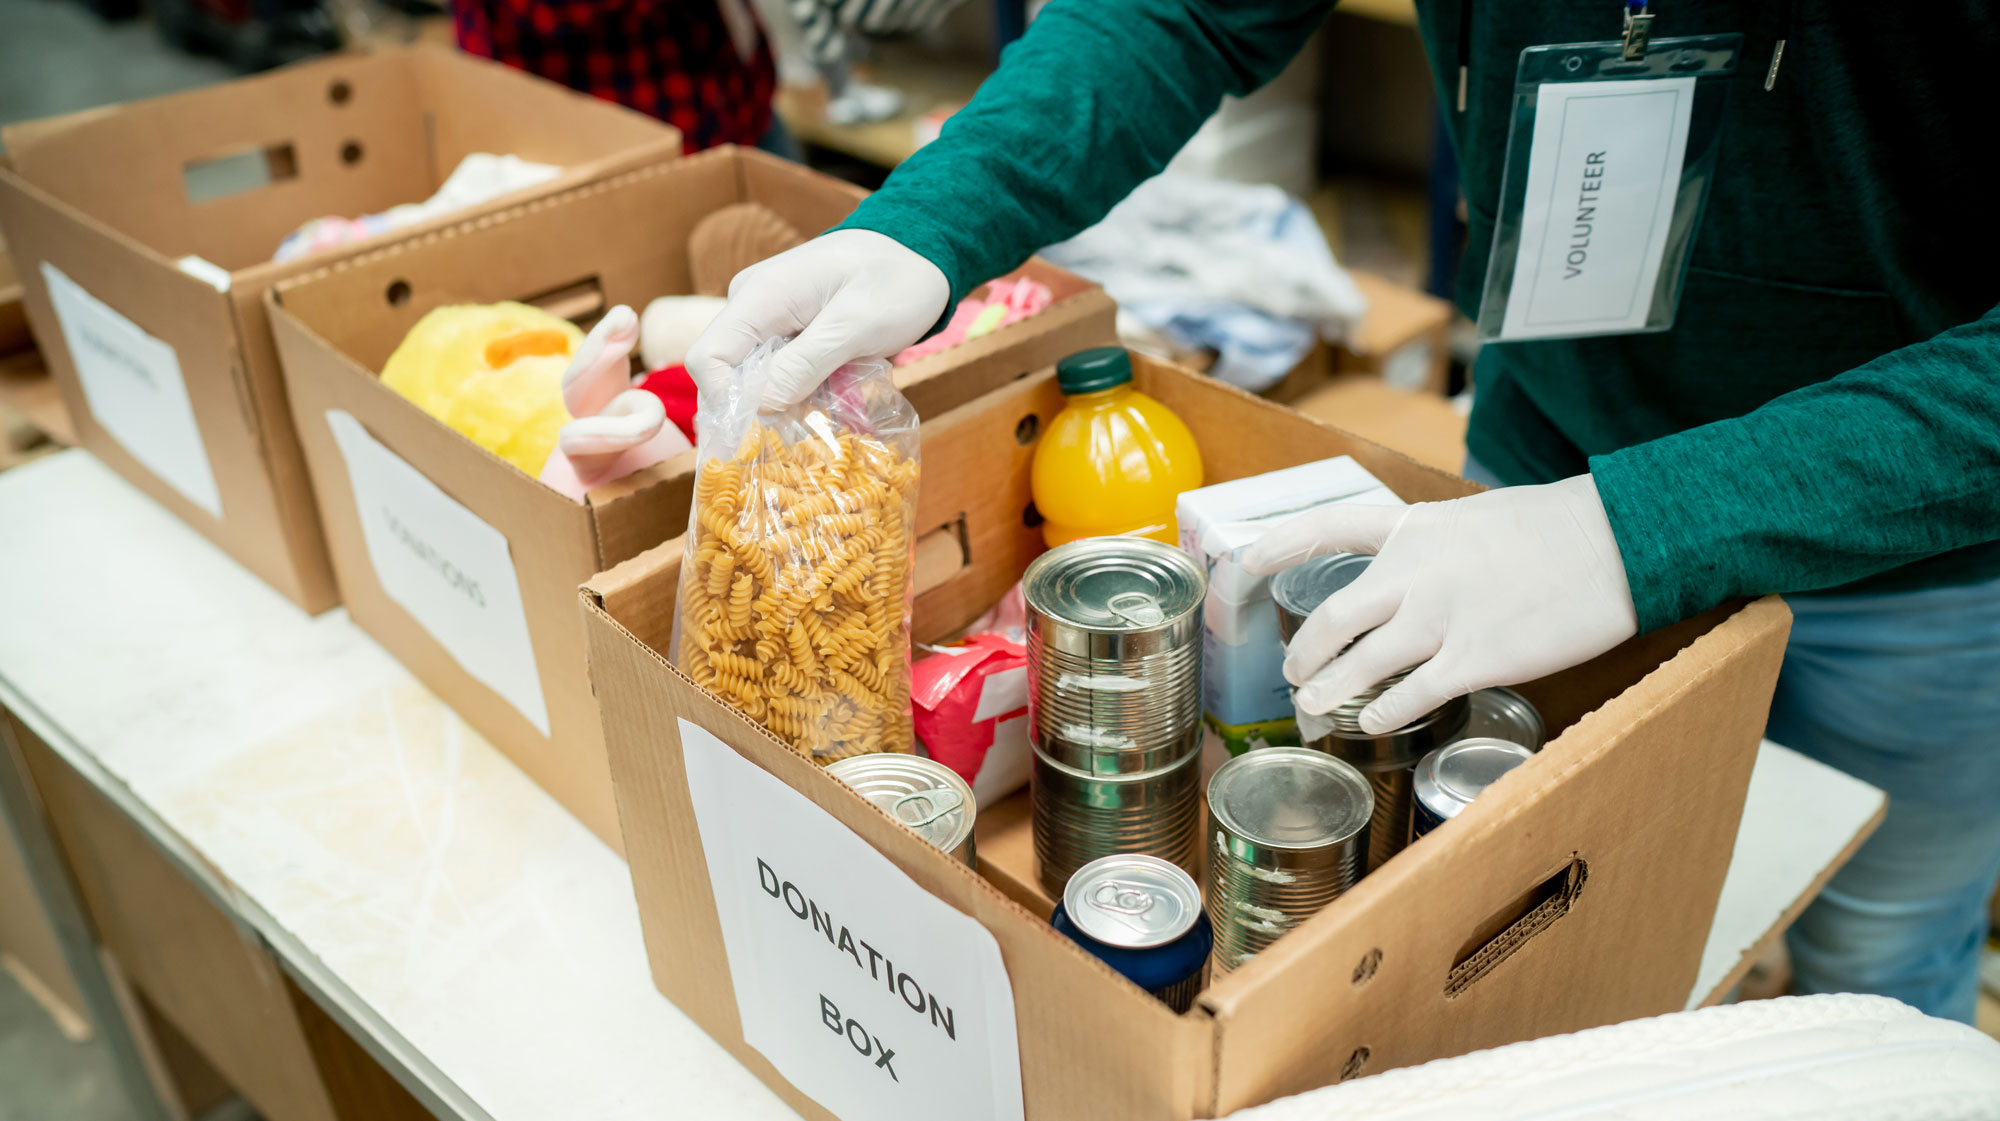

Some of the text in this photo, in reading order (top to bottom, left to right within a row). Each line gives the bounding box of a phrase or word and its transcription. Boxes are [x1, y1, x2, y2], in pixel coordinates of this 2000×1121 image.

[1562, 150, 1607, 281] VOLUNTEER
[756, 856, 957, 1042] DONATION
[818, 992, 900, 1084] BOX
